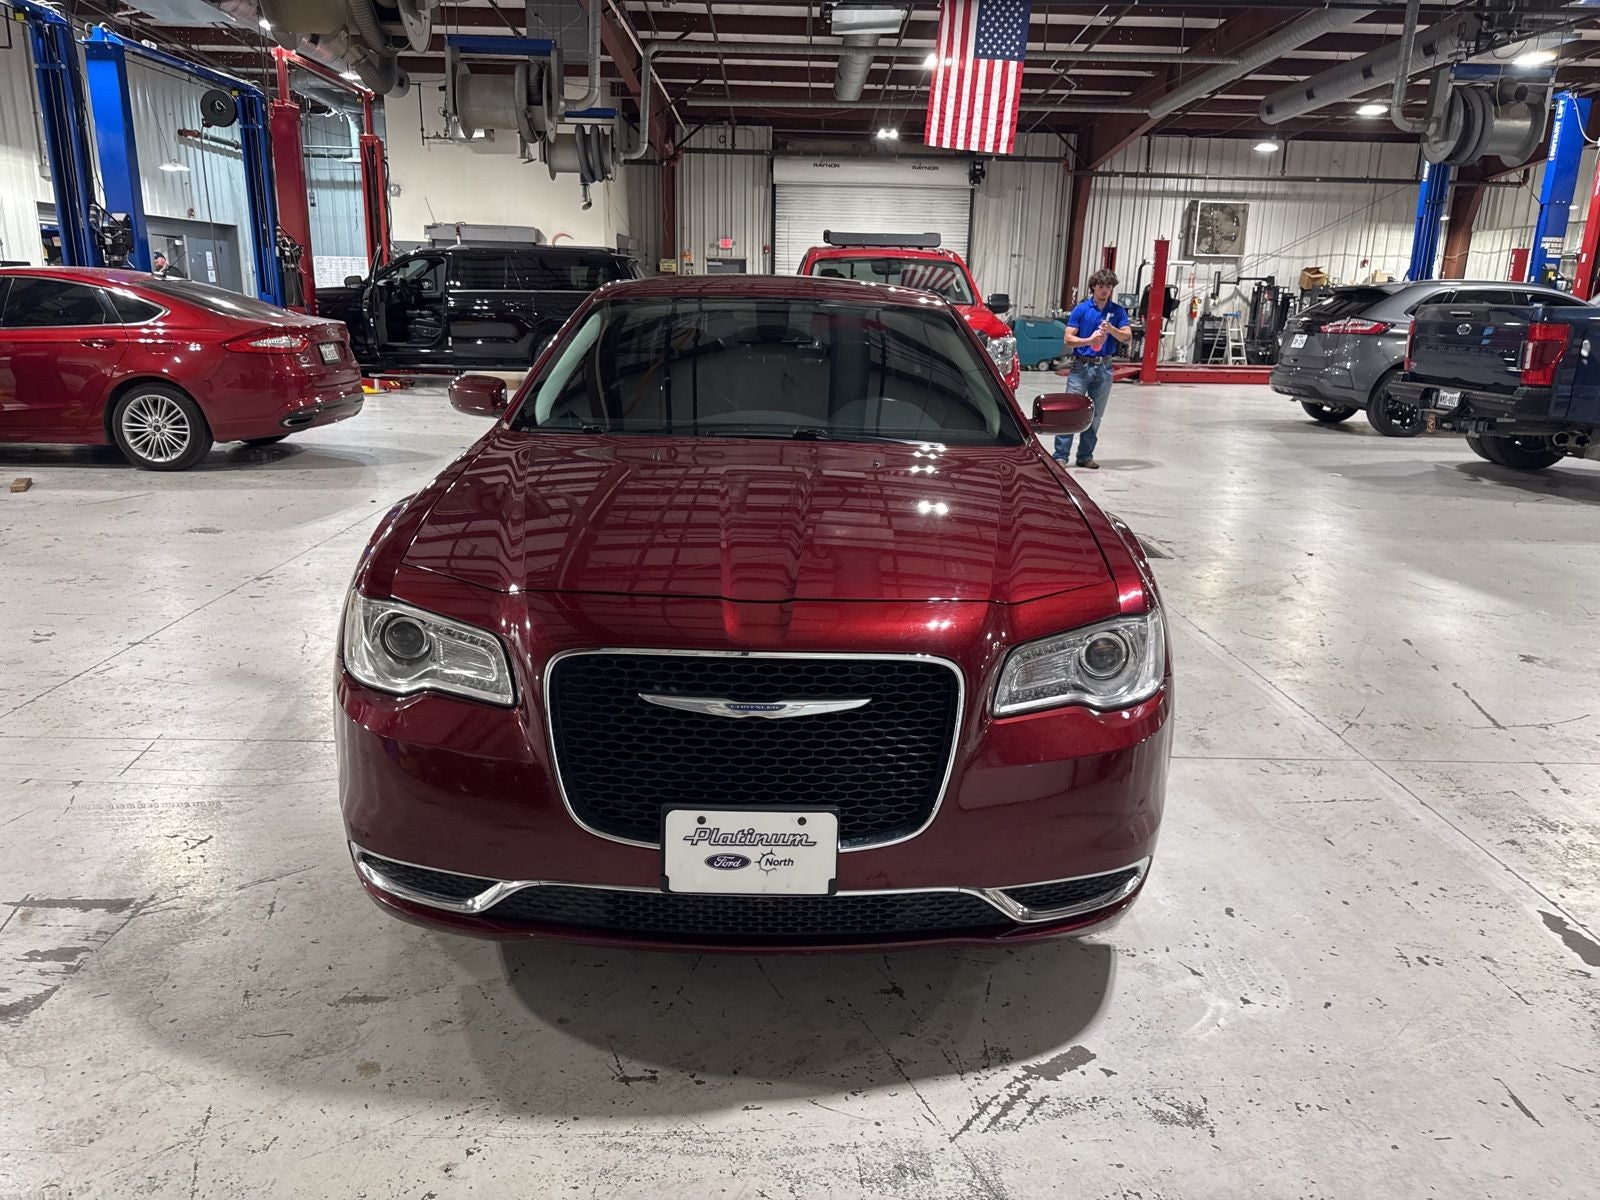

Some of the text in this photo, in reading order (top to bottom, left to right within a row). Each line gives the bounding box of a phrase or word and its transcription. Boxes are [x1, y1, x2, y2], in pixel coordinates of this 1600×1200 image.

[683, 828, 817, 847] Platinum
[713, 855, 741, 868] Ford
[764, 857, 794, 867] North
